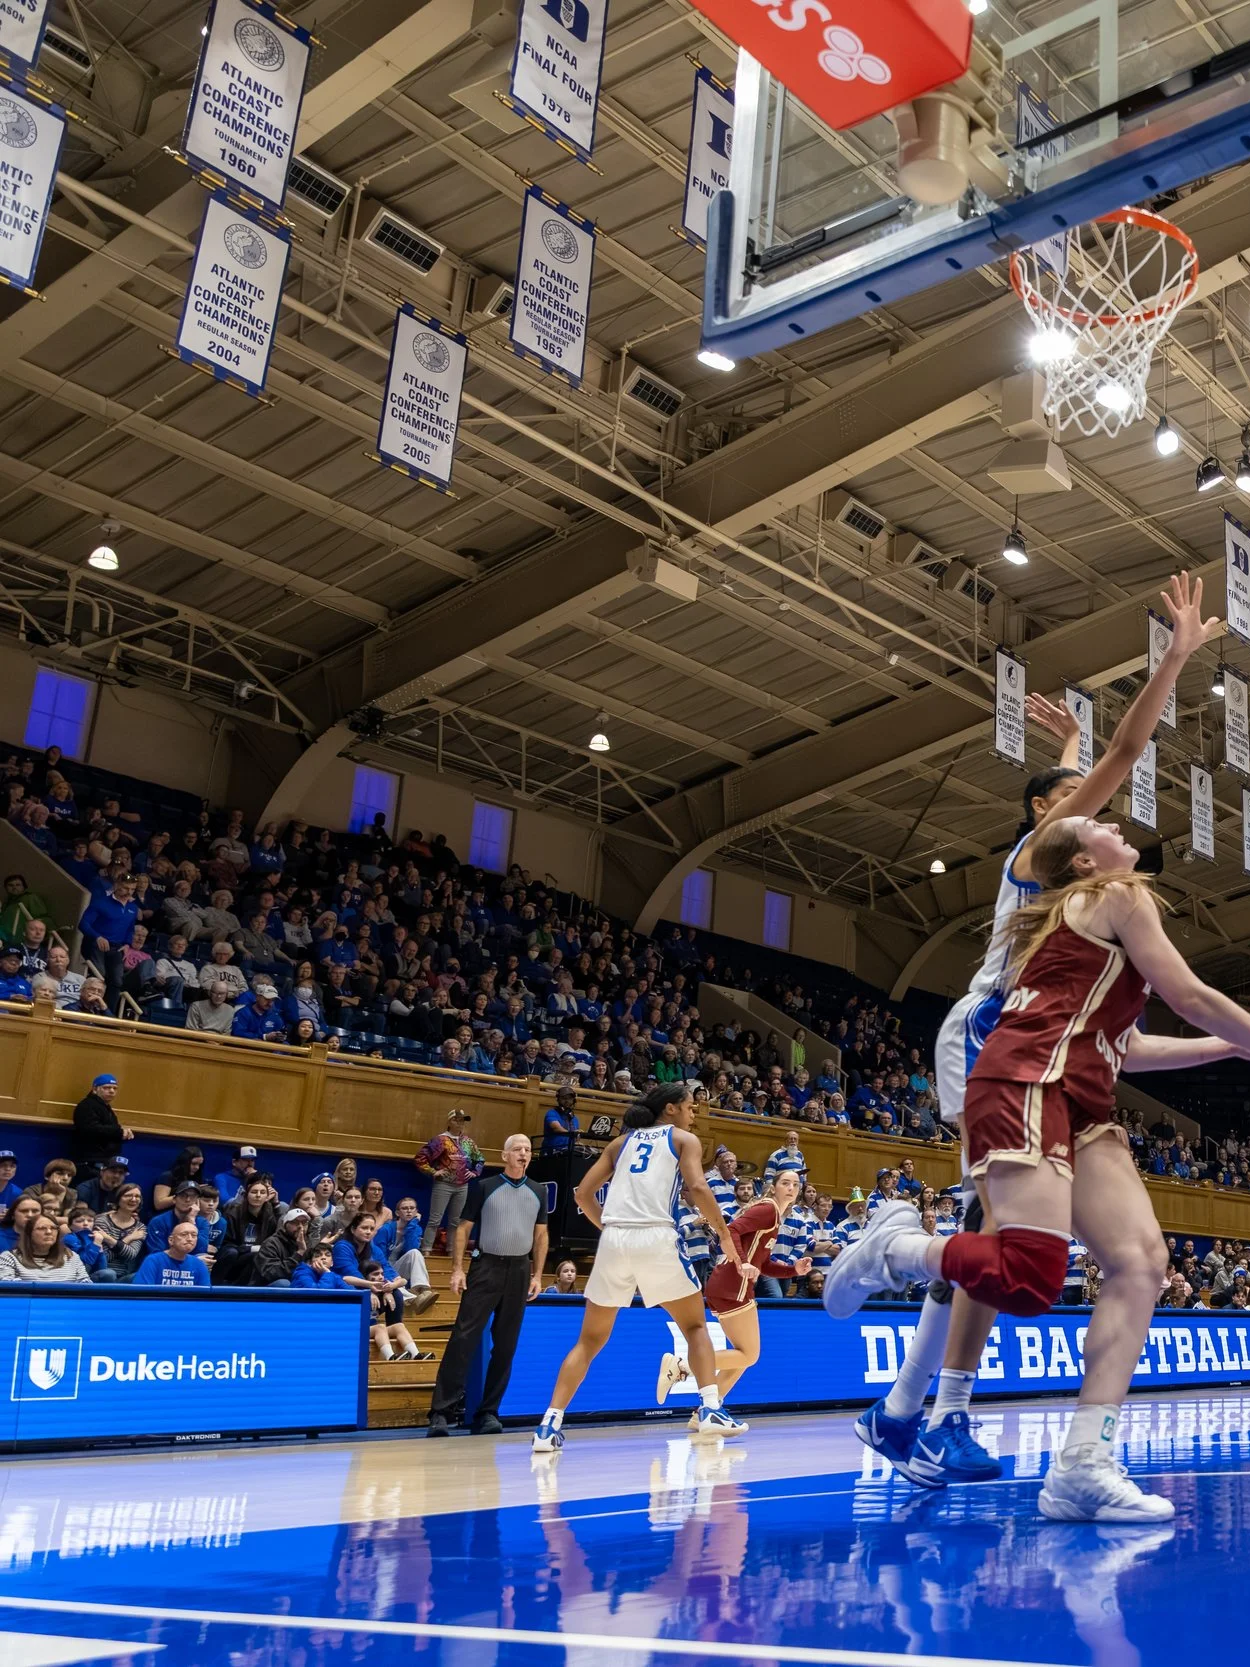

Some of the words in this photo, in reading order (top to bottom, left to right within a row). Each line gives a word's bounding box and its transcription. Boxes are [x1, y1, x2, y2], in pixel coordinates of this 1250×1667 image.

[546, 34, 577, 70] NCAA
[221, 61, 284, 108] ATLANTIC
[522, 42, 558, 78] FINAL
[562, 72, 593, 106] FOUR
[202, 83, 291, 146] CONFERENCE
[228, 82, 272, 117] COAST
[542, 93, 571, 124] 1978
[203, 101, 284, 159] CHAMPIONS
[214, 127, 268, 165] TOURNAMENT
[219, 147, 257, 179] 1960
[210, 263, 265, 301] ATLANTIC
[533, 259, 579, 294] ATLANTIC
[539, 277, 571, 303] COAST
[193, 284, 271, 335] CONFERENCE
[217, 281, 256, 310] COAST
[521, 280, 585, 327] CONFERENCE
[194, 300, 265, 346] CHAMPIONS
[523, 295, 582, 338] CHAMPIONS
[526, 310, 551, 330] REGULAR
[553, 326, 576, 344] SEASON
[197, 319, 229, 342] REGULAR
[230, 337, 257, 356] SEASON
[531, 321, 570, 349] TOURNAMENT
[536, 335, 563, 359] 1963
[207, 340, 241, 367] 2004
[402, 372, 450, 403] ATLANTIC
[408, 388, 441, 412] COAST
[390, 393, 455, 433] CONFERENCE
[391, 407, 450, 445] CHAMPIONS
[400, 427, 438, 451] TOURNAMENT
[402, 443, 431, 464] 2005
[1229, 589, 1242, 605] FINAL
[1235, 580, 1247, 594] NCAA
[1001, 692, 1021, 708] ATLANTIC
[1004, 703, 1019, 714] COAST
[998, 708, 1024, 728] CONFERENCE
[999, 718, 1024, 737] CHAMPIONS
[634, 1129, 668, 1140] ACKSON
[630, 1143, 653, 1174] 3
[176, 1433, 221, 1441] DAKTRONICS
